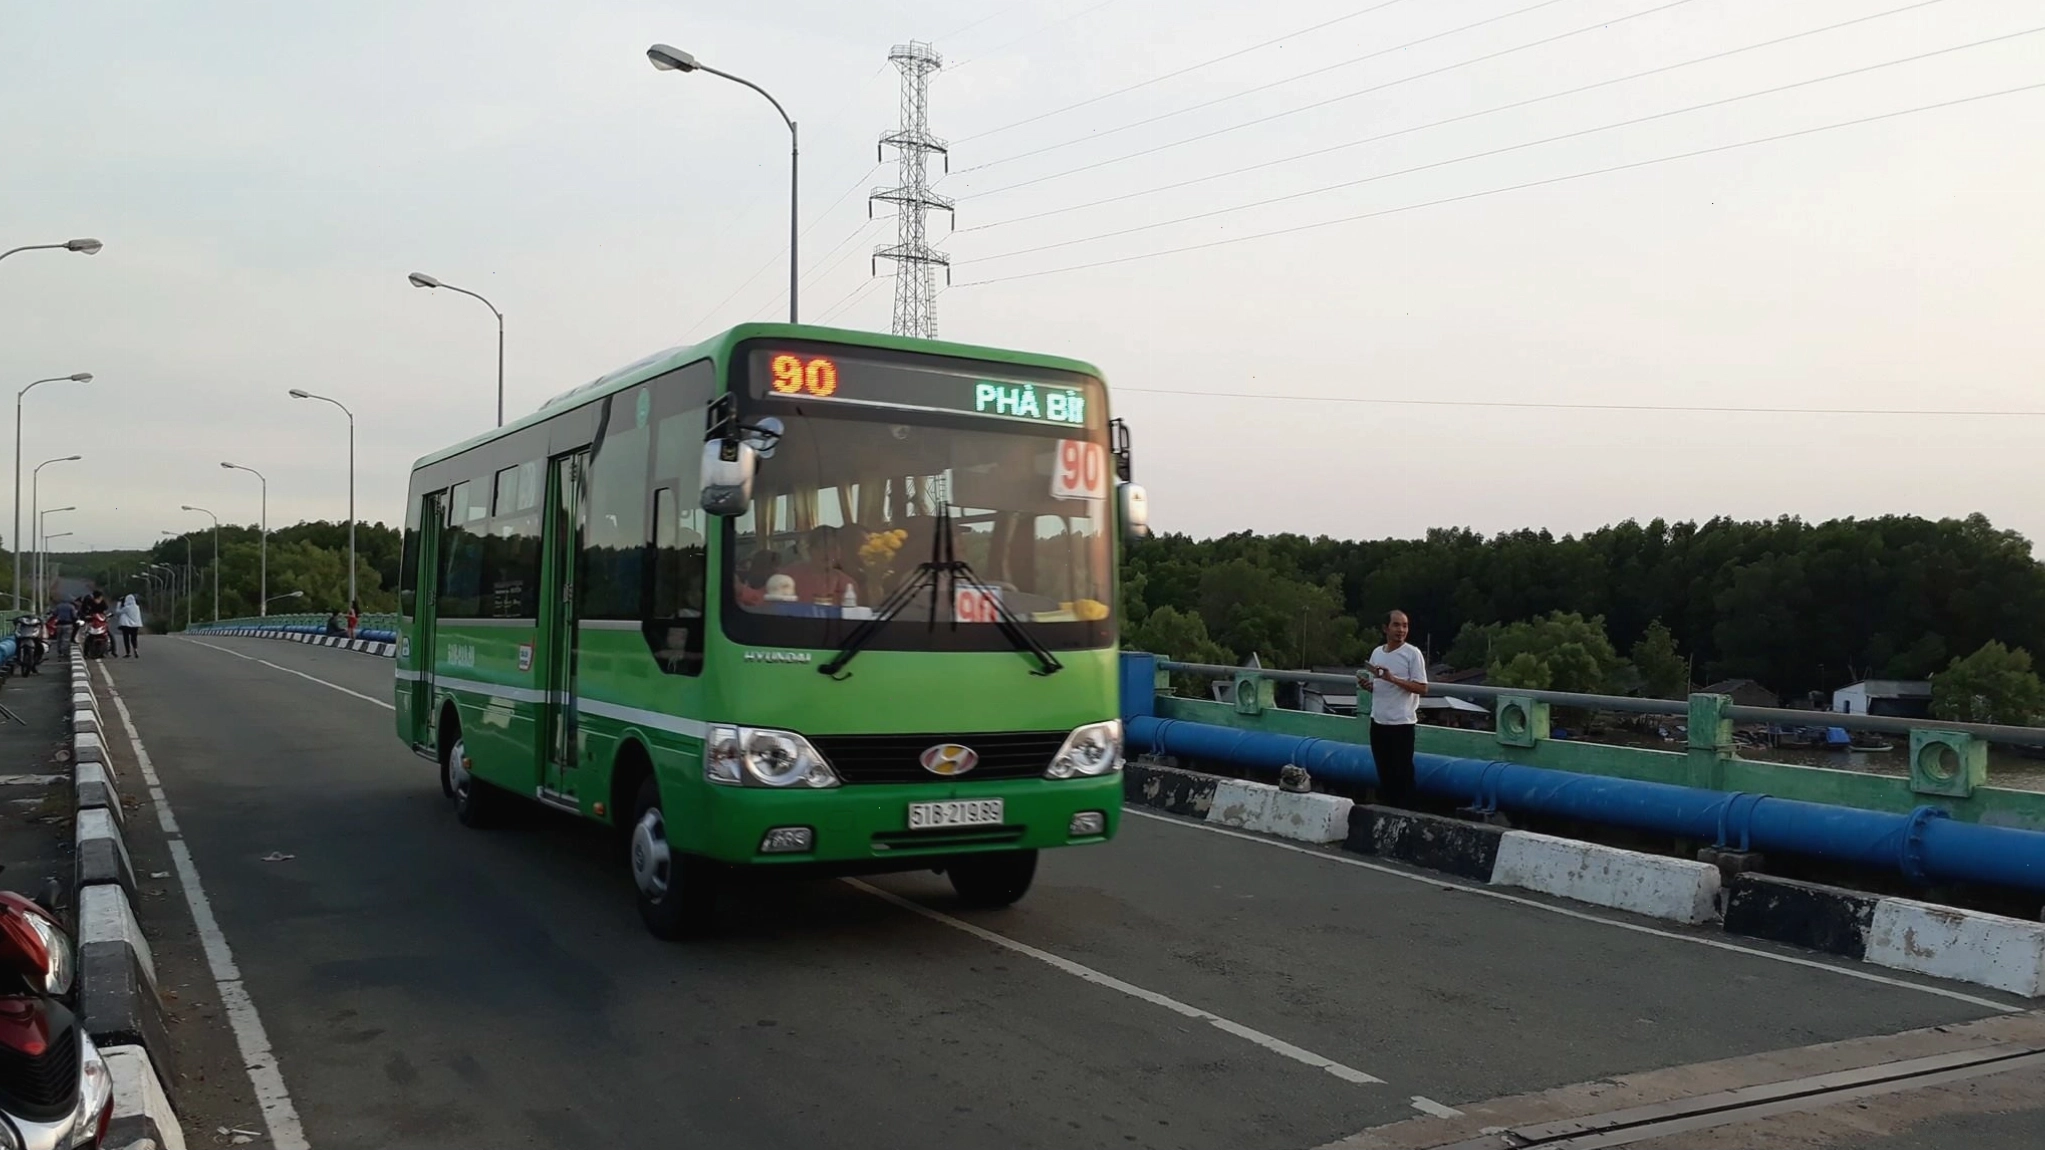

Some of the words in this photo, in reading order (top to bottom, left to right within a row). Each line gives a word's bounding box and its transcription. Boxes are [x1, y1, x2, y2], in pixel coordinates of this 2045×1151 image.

[772, 355, 837, 397] 90
[1062, 438, 1099, 491] 90
[744, 651, 812, 663] HYUNDAI
